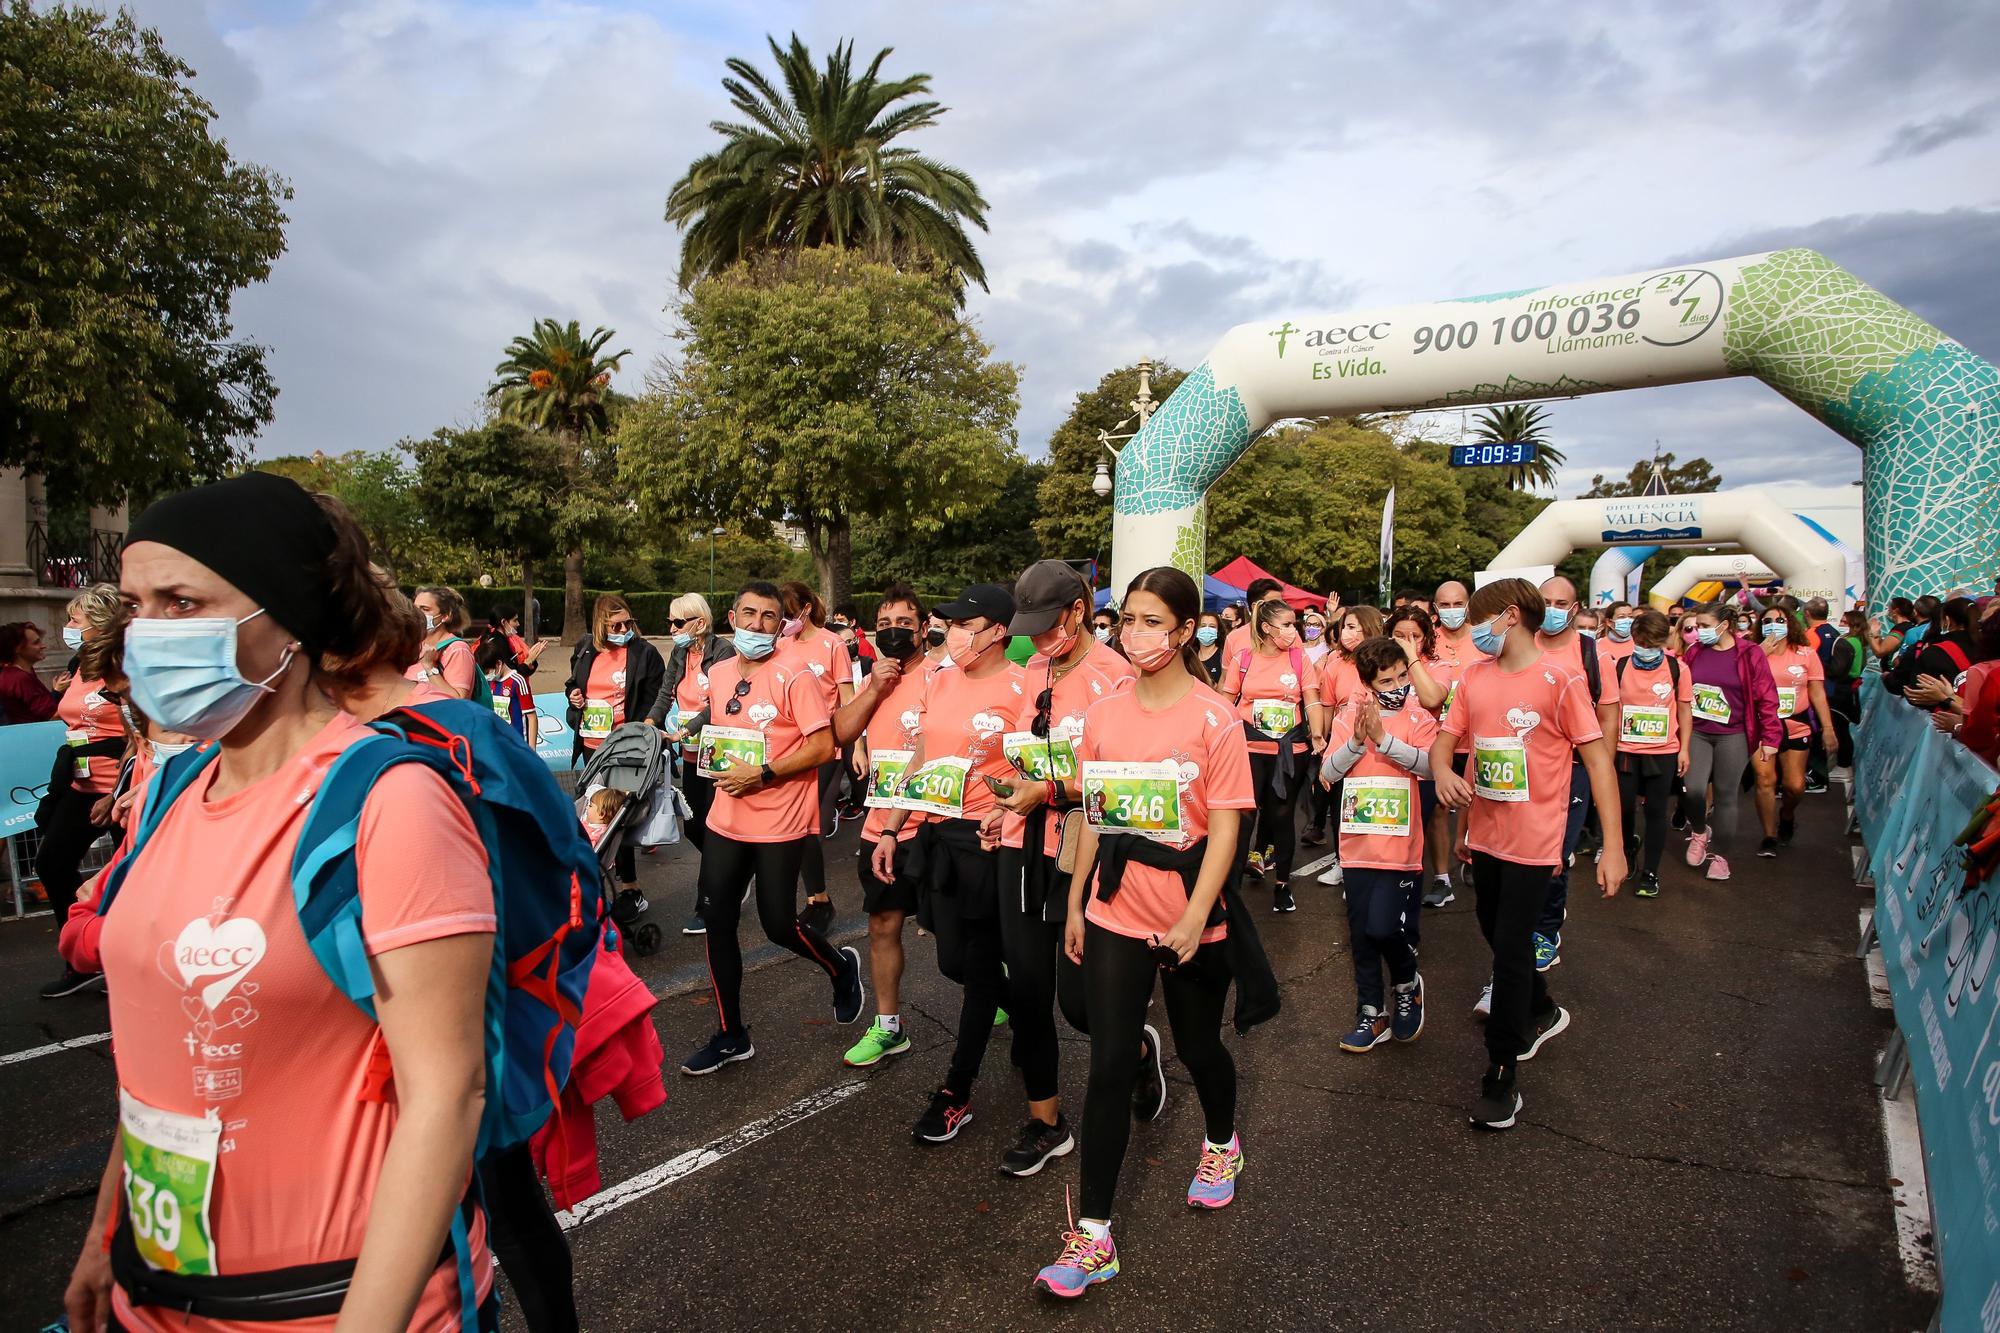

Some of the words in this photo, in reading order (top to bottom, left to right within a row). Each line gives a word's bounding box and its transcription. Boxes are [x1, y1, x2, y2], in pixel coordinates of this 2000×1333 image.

[1656, 274, 1685, 289] 24
[1527, 286, 1645, 313] infocáncer
[1680, 297, 1700, 323] 7
[1305, 322, 1391, 347] aecc
[1413, 320, 1479, 355] 900
[1492, 310, 1558, 345] 100
[1566, 298, 1641, 336] 036
[1319, 348, 1342, 356] Contra
[1344, 346, 1350, 354] el
[1546, 330, 1640, 354] Llámame.
[1312, 362, 1332, 380] Es
[1338, 356, 1386, 378] Vida.
[588, 714, 607, 728] 297
[1267, 713, 1289, 728] 328
[1635, 720, 1664, 733] 1059
[1482, 761, 1514, 783] 326
[915, 773, 955, 799] 330
[1116, 794, 1165, 822] 346
[1363, 798, 1401, 819] 333
[180, 946, 254, 967] aecc
